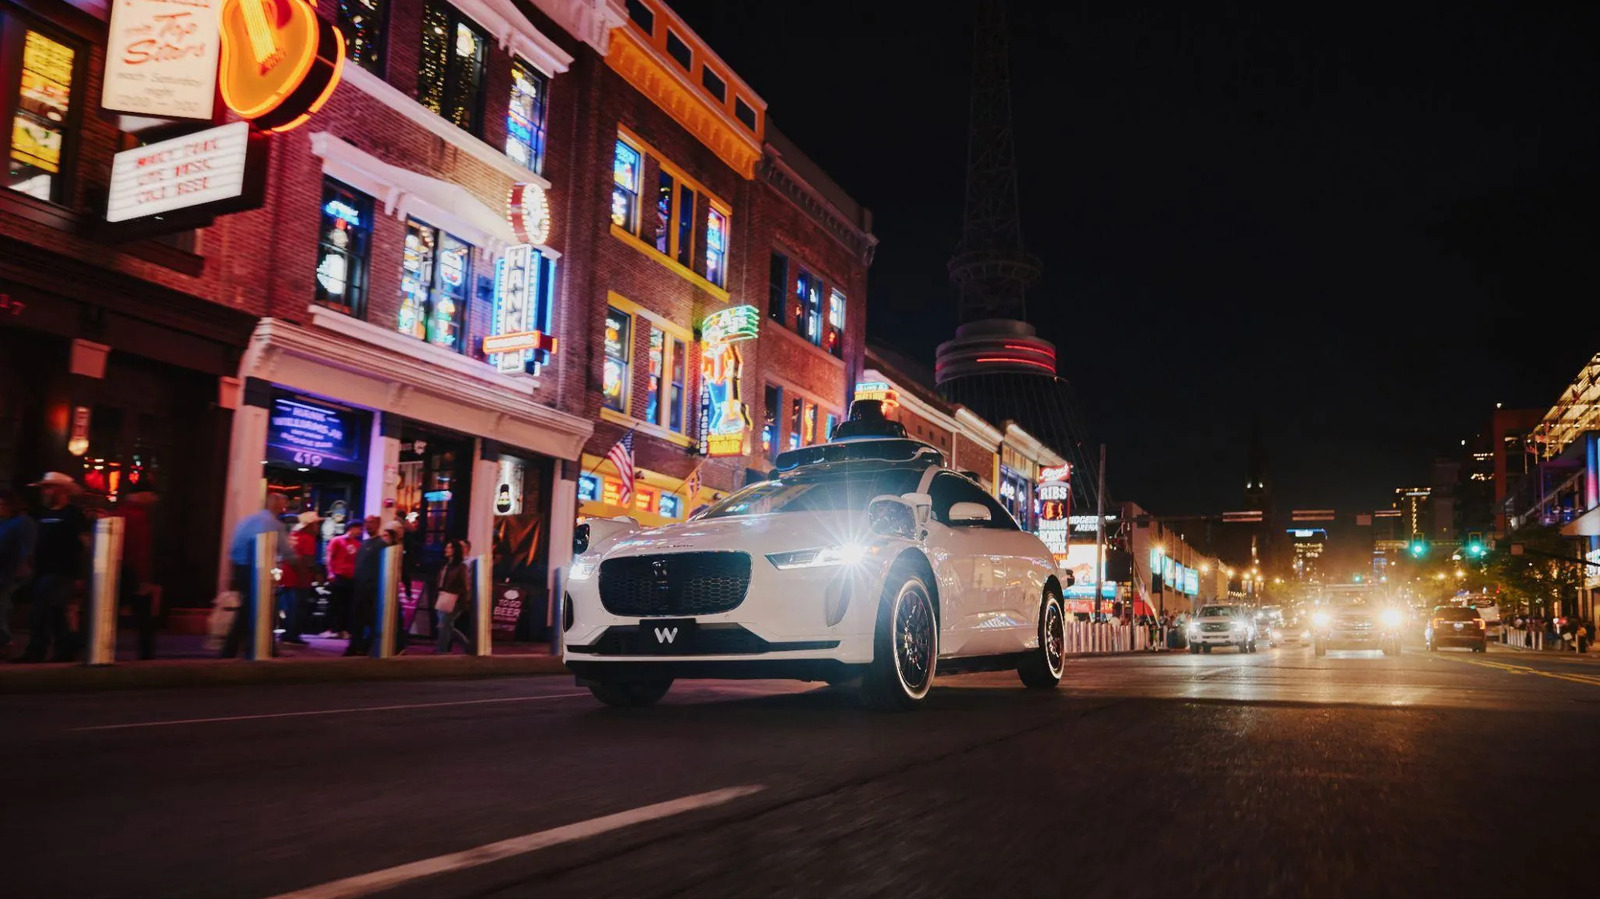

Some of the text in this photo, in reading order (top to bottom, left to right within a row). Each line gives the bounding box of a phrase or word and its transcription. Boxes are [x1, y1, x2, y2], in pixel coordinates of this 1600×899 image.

[293, 452, 323, 467] 419
[1040, 486, 1068, 500] RIBS
[509, 600, 521, 608] GO
[493, 606, 521, 616] BEER
